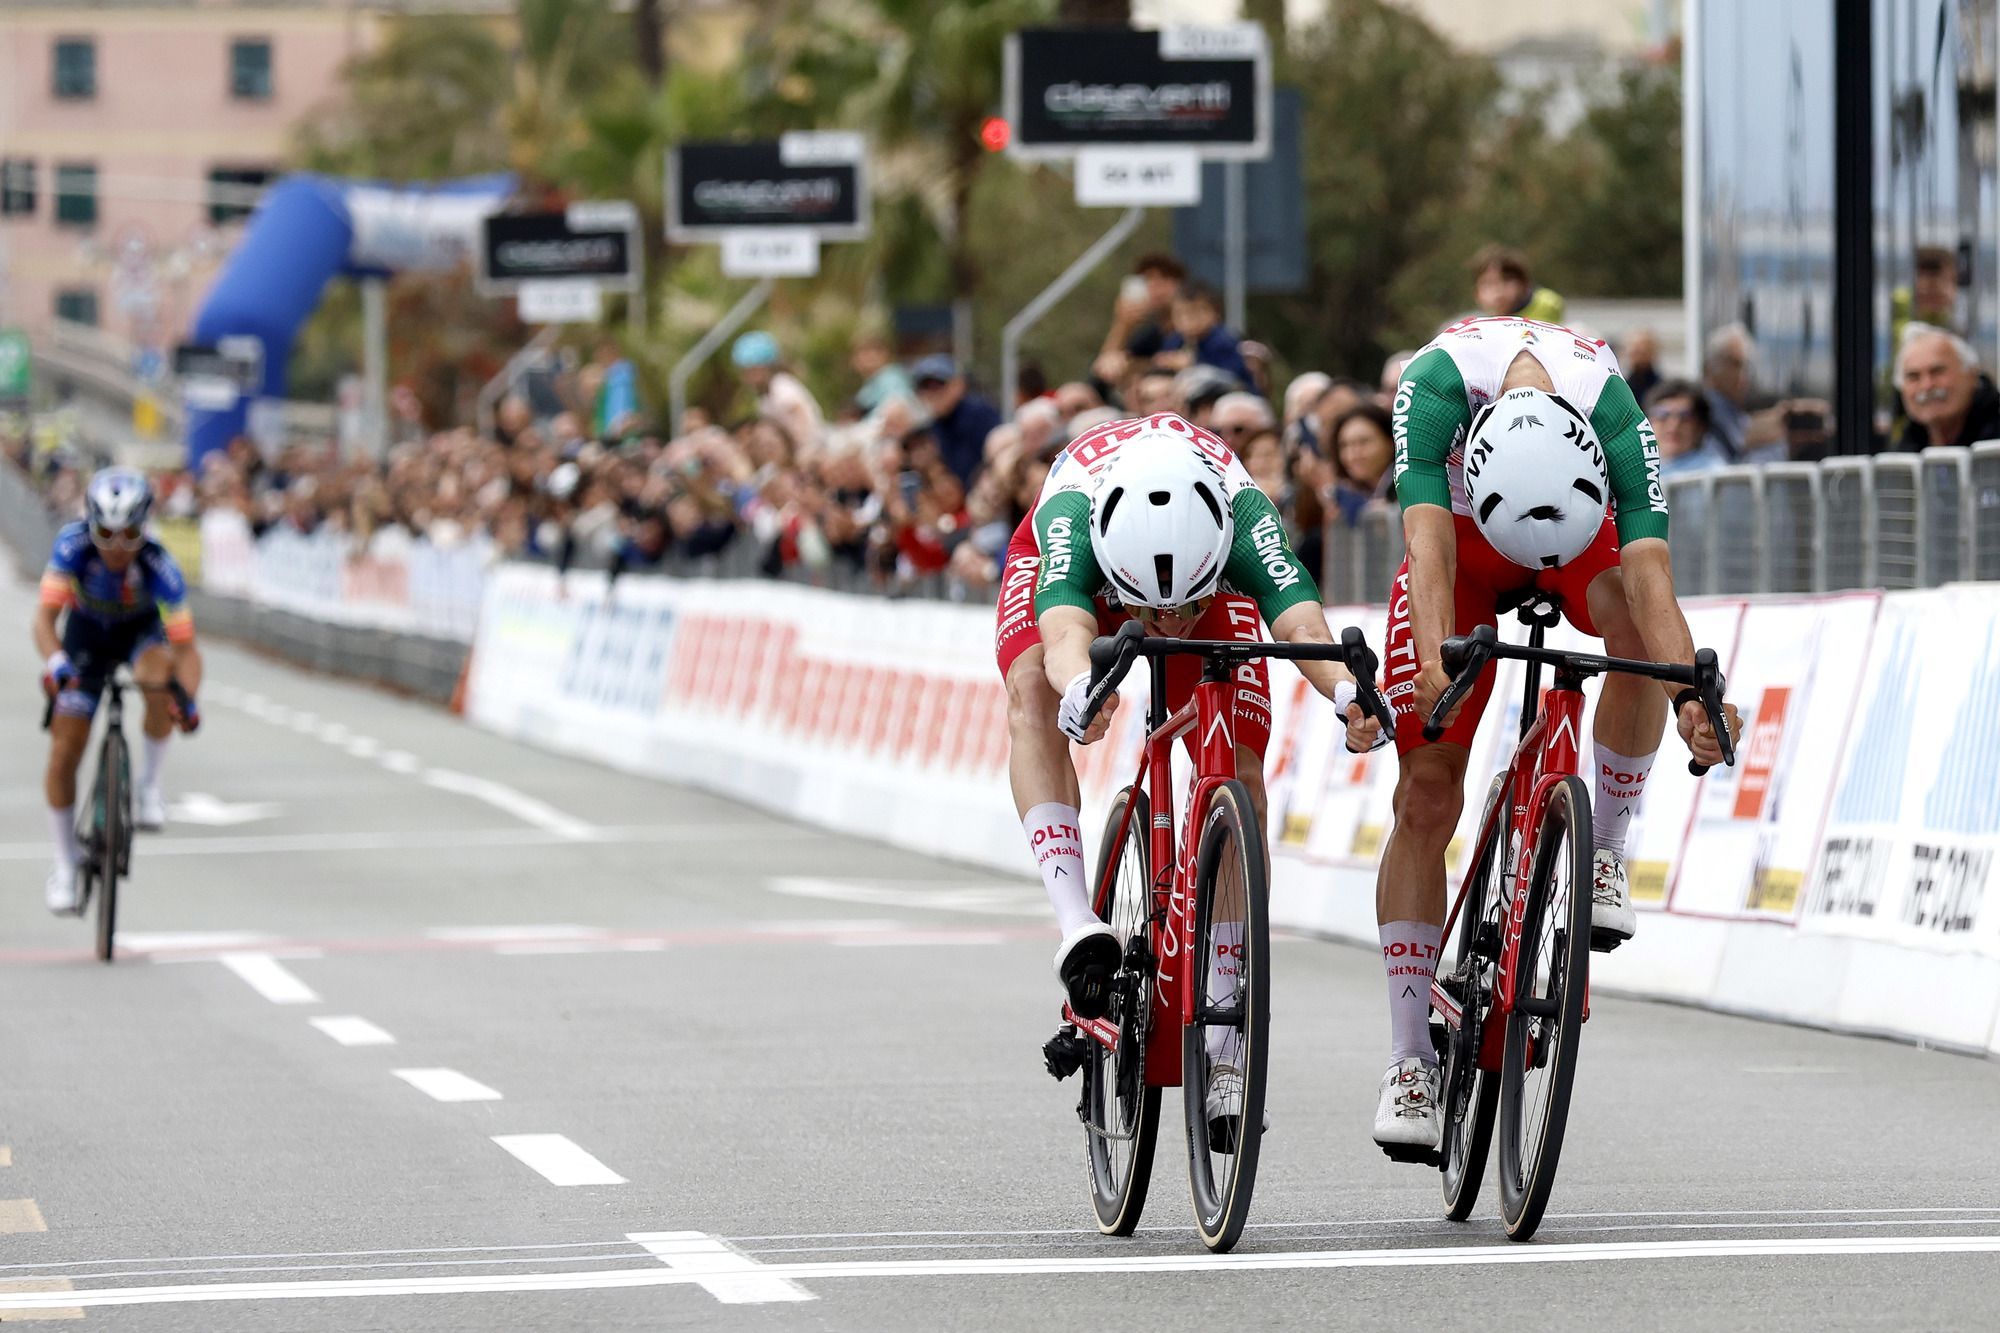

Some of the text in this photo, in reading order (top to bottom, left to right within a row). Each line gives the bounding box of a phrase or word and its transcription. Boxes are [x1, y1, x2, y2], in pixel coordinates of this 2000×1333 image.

[1393, 380, 1416, 481] KOMETA
[1636, 417, 1669, 514] KOMETA
[1004, 556, 1040, 617] POLTI
[1043, 516, 1072, 588] KOMETA
[1120, 567, 1139, 586] POLTI
[1250, 514, 1300, 592] KOMETA
[1093, 1025, 1112, 1044] SRAM
